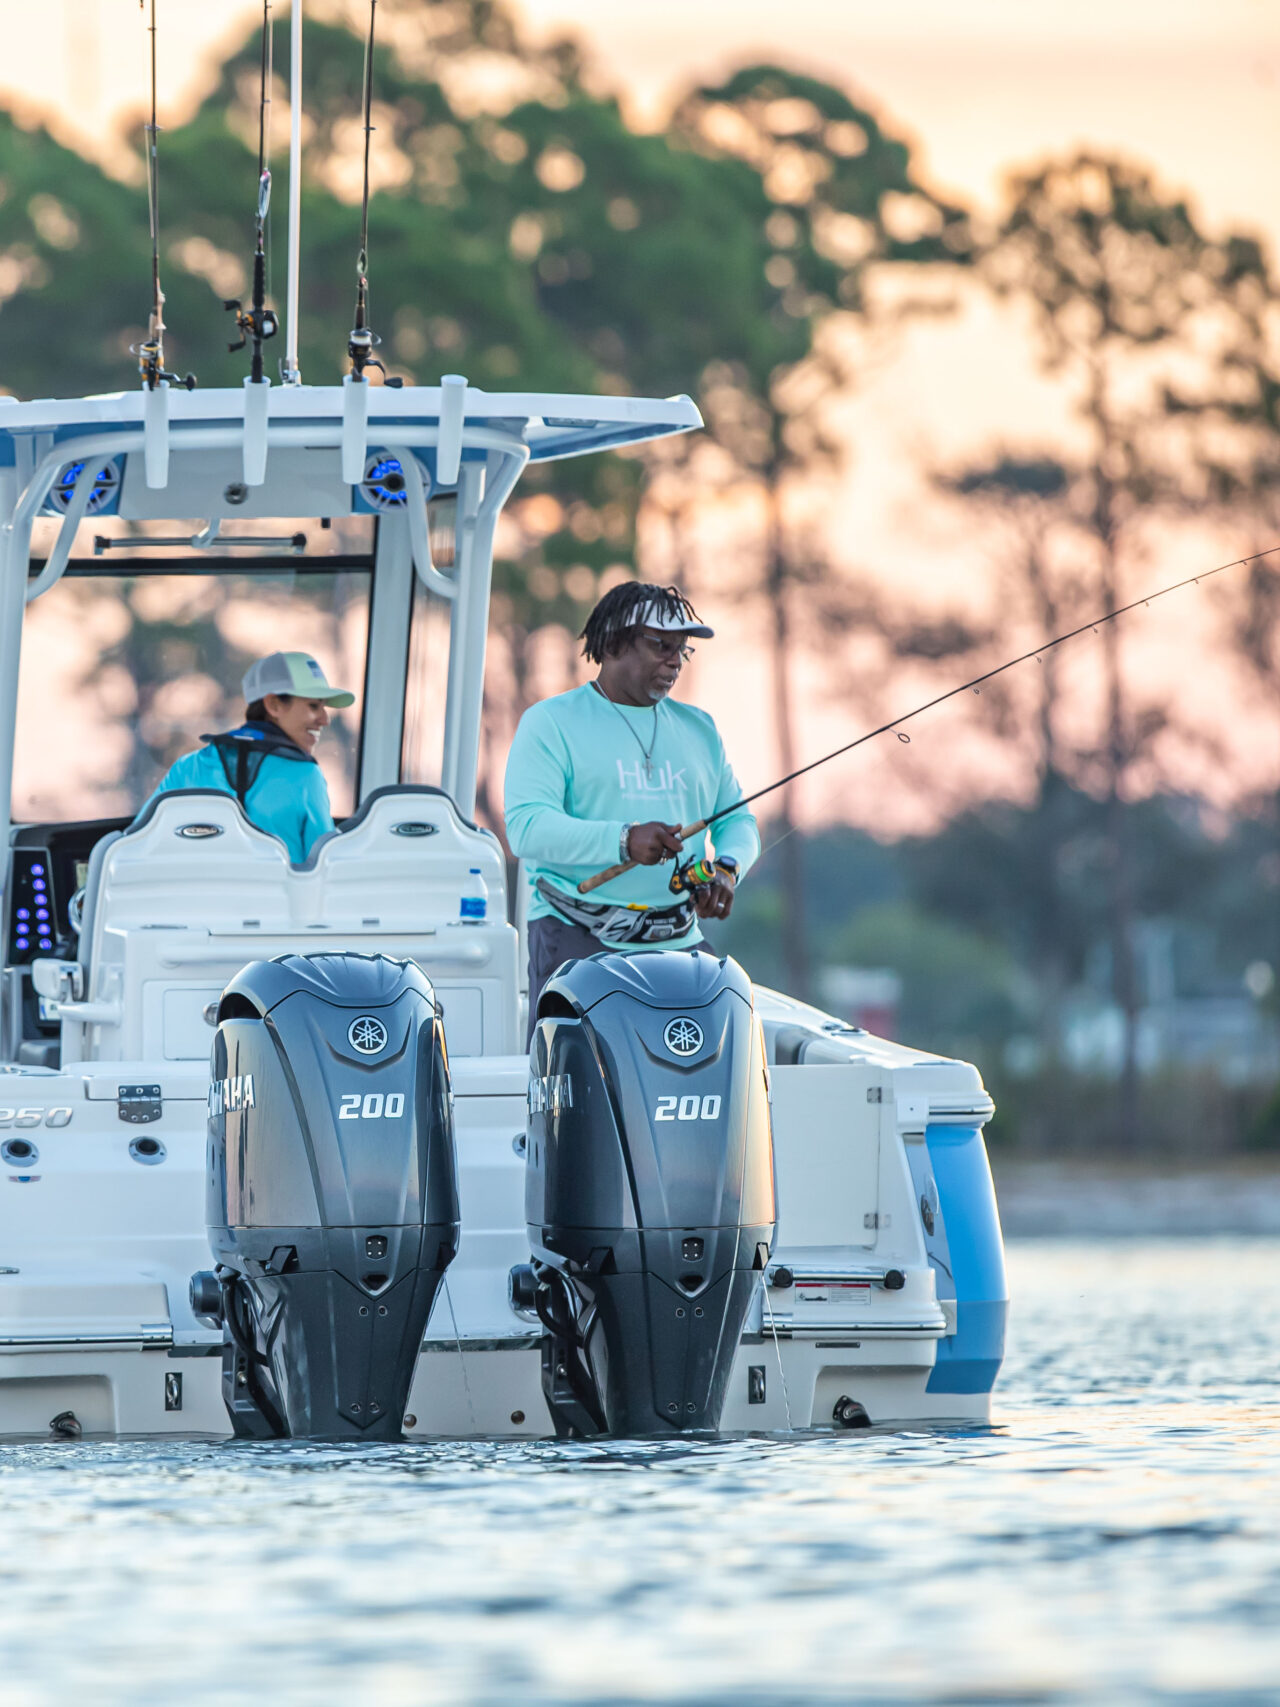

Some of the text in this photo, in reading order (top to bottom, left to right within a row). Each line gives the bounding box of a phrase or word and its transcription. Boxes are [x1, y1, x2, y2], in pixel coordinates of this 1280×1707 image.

[208, 1074, 256, 1118] MAHA
[338, 1093, 405, 1120] 200
[654, 1095, 721, 1121] 200
